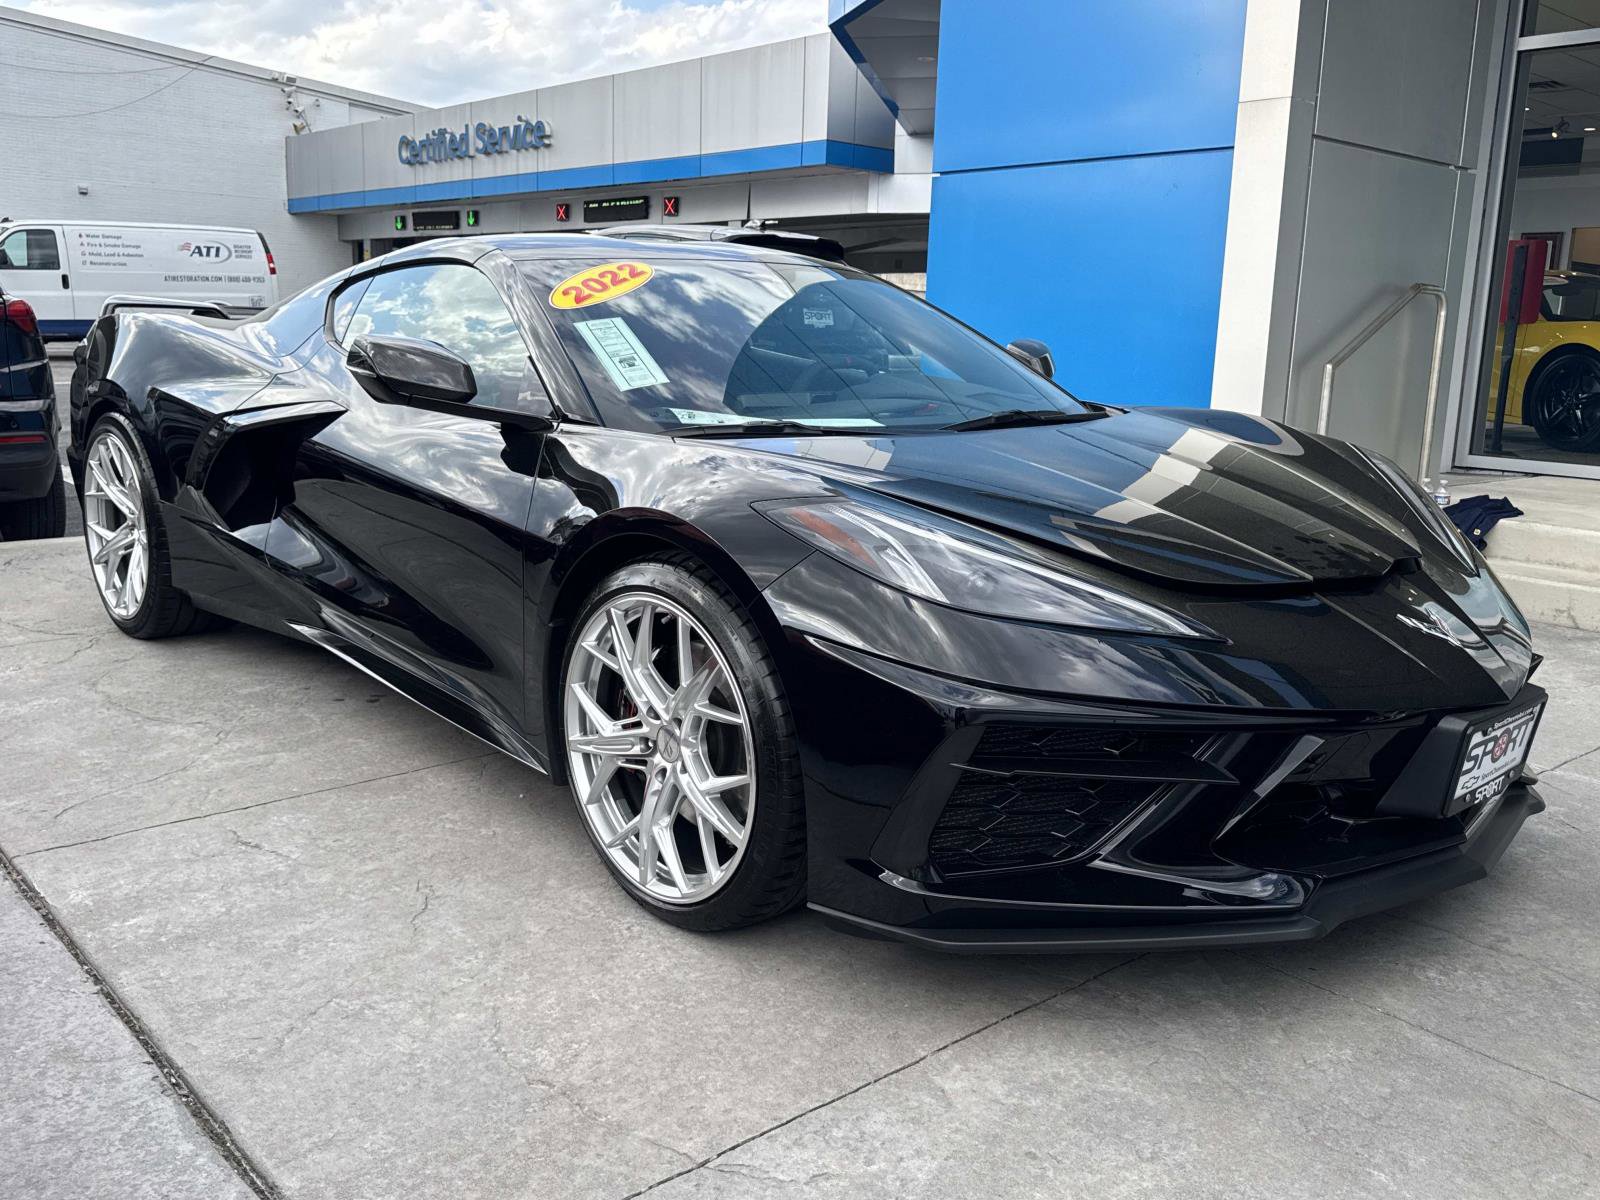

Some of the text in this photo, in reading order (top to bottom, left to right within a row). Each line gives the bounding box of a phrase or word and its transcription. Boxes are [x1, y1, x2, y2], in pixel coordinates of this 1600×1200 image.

[398, 115, 548, 165] Certified Service
[189, 245, 221, 258] ATI
[561, 263, 648, 305] 2022
[1461, 715, 1535, 777] SPORT
[1474, 775, 1506, 804] SPORT
